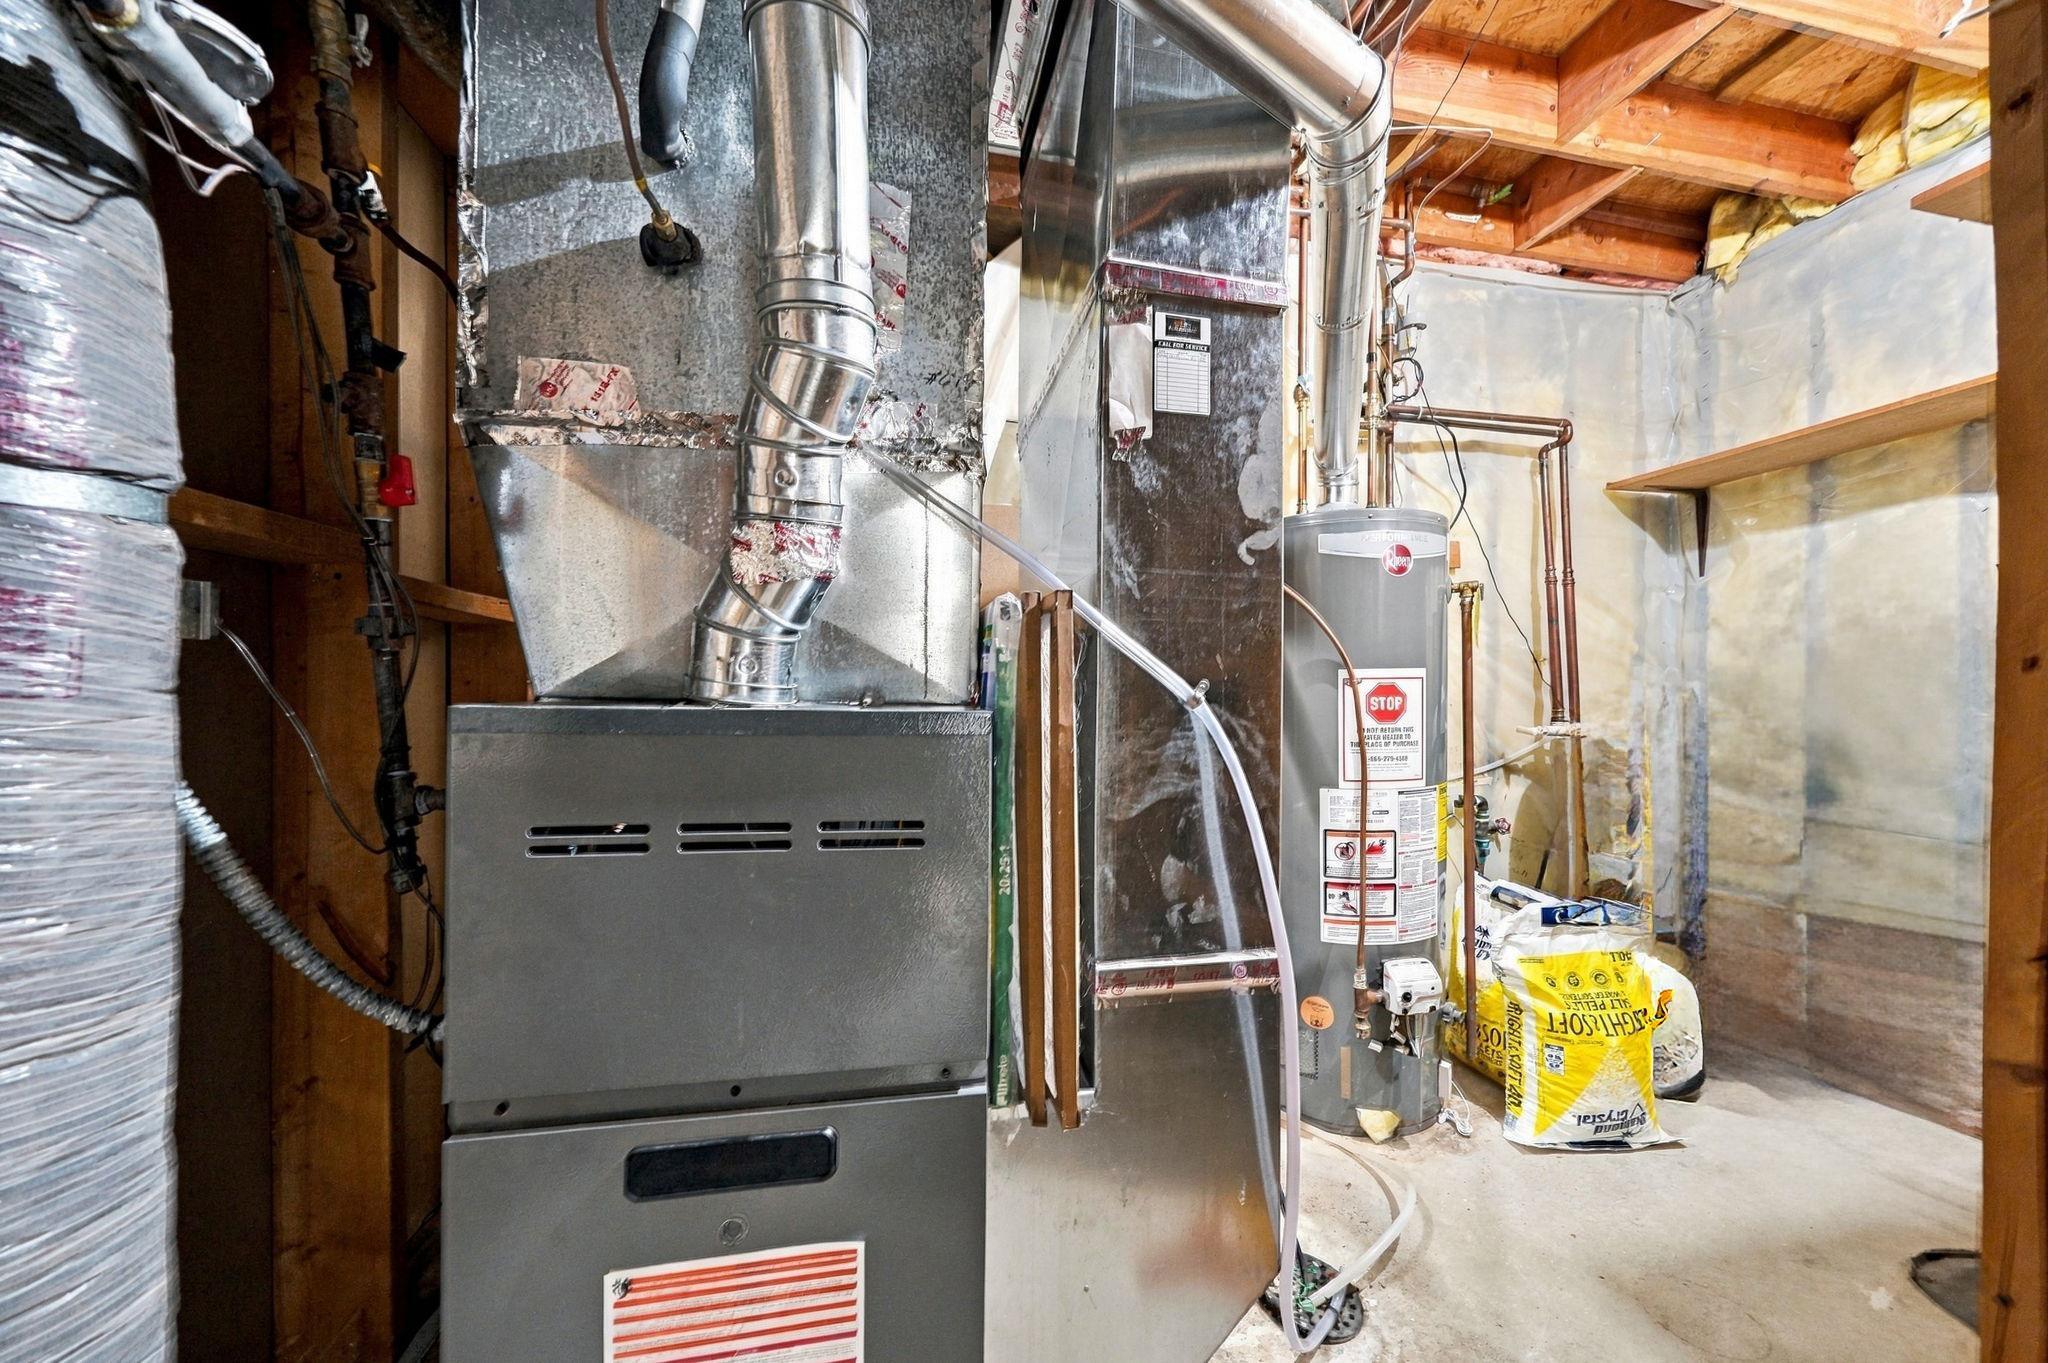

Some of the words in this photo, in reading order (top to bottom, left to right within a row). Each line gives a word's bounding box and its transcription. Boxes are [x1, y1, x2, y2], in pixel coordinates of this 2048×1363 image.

[1185, 343, 1208, 352] SERVICE
[1386, 544, 1411, 571] Rheem
[1000, 600, 1011, 620] 3M
[1370, 696, 1403, 711] STOP
[1392, 740, 1419, 748] PURCHASE
[1547, 1011, 1593, 1037] SOFT
[1577, 1110, 1629, 1127] Crystal
[1593, 1112, 1647, 1136] Diamond
